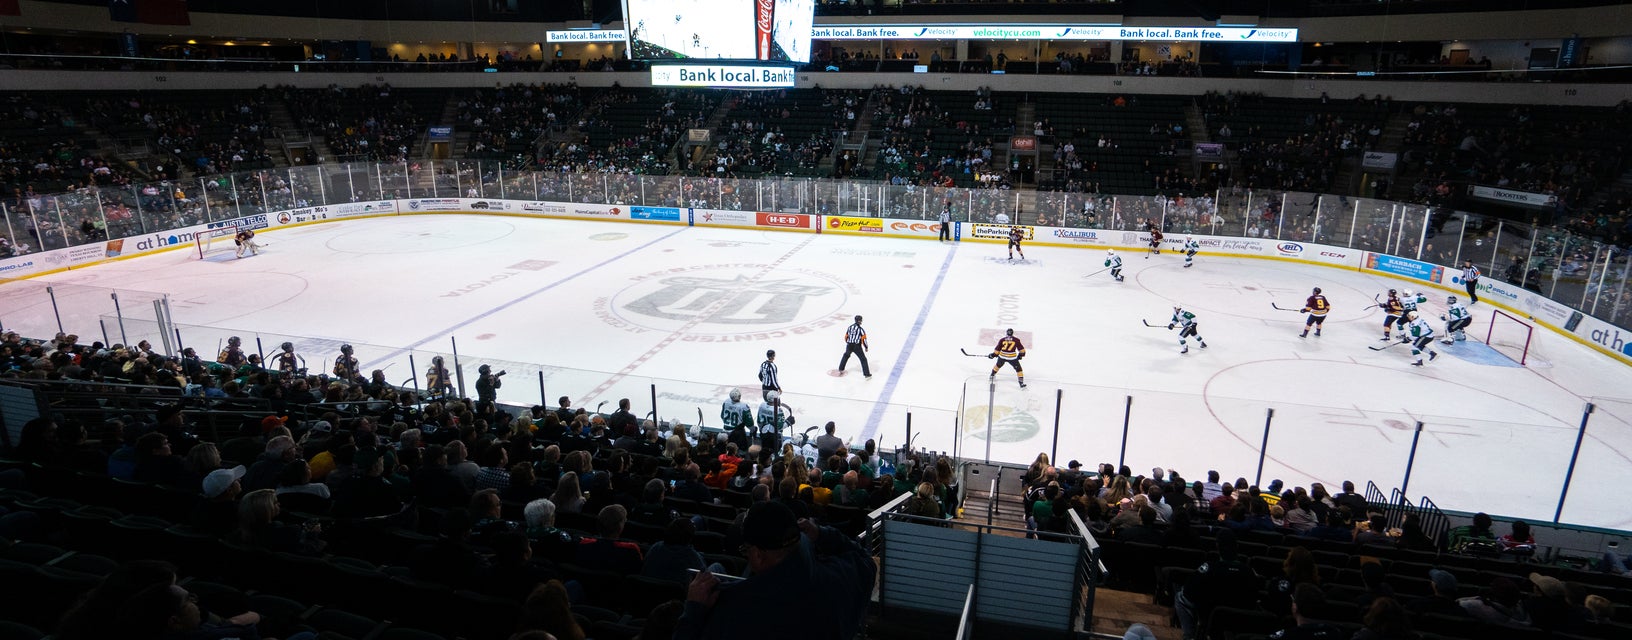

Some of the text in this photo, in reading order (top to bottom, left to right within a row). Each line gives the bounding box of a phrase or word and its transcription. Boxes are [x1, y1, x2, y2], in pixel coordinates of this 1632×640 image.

[551, 31, 625, 40] Bank local. Bank free.
[811, 28, 899, 37] Bank local. Bank free.
[928, 28, 956, 36] Velocity
[973, 28, 1041, 38] velocitycu.com
[1072, 28, 1101, 36] Velocity
[1120, 29, 1223, 39] Bank local. Bank free.
[1257, 30, 1289, 39] Velocity
[680, 68, 716, 82] Bank
[720, 67, 760, 82] local.
[763, 69, 788, 83] Bank
[222, 215, 267, 228] AUSTIN TELCO
[1054, 229, 1097, 239] EXCALIBUR
[137, 237, 154, 251] at
[1320, 251, 1346, 259] CCM
[1316, 299, 1324, 309] 9
[1591, 329, 1609, 346] at
[1001, 340, 1016, 351] 37
[724, 409, 739, 426] 20
